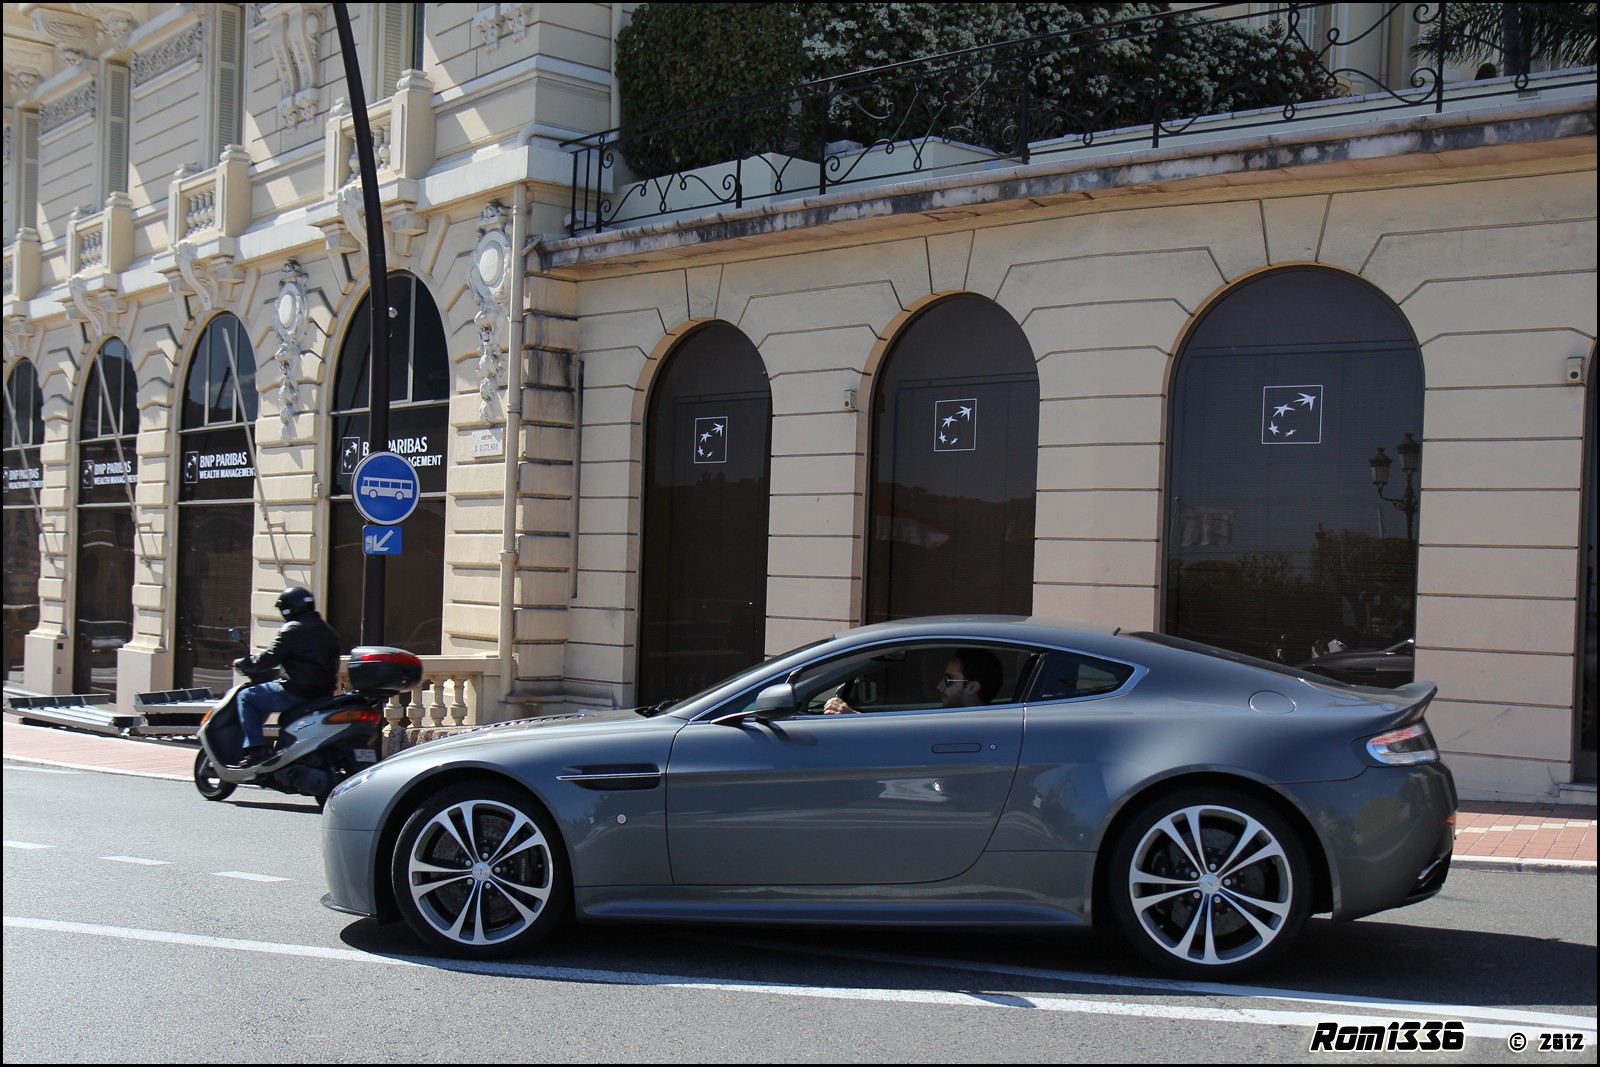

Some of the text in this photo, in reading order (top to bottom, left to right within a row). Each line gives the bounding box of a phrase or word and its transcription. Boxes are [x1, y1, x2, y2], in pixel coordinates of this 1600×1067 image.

[200, 452, 247, 468] BNP PARIBAS
[405, 455, 443, 467] AGEMENT
[199, 470, 219, 480] WEALTH
